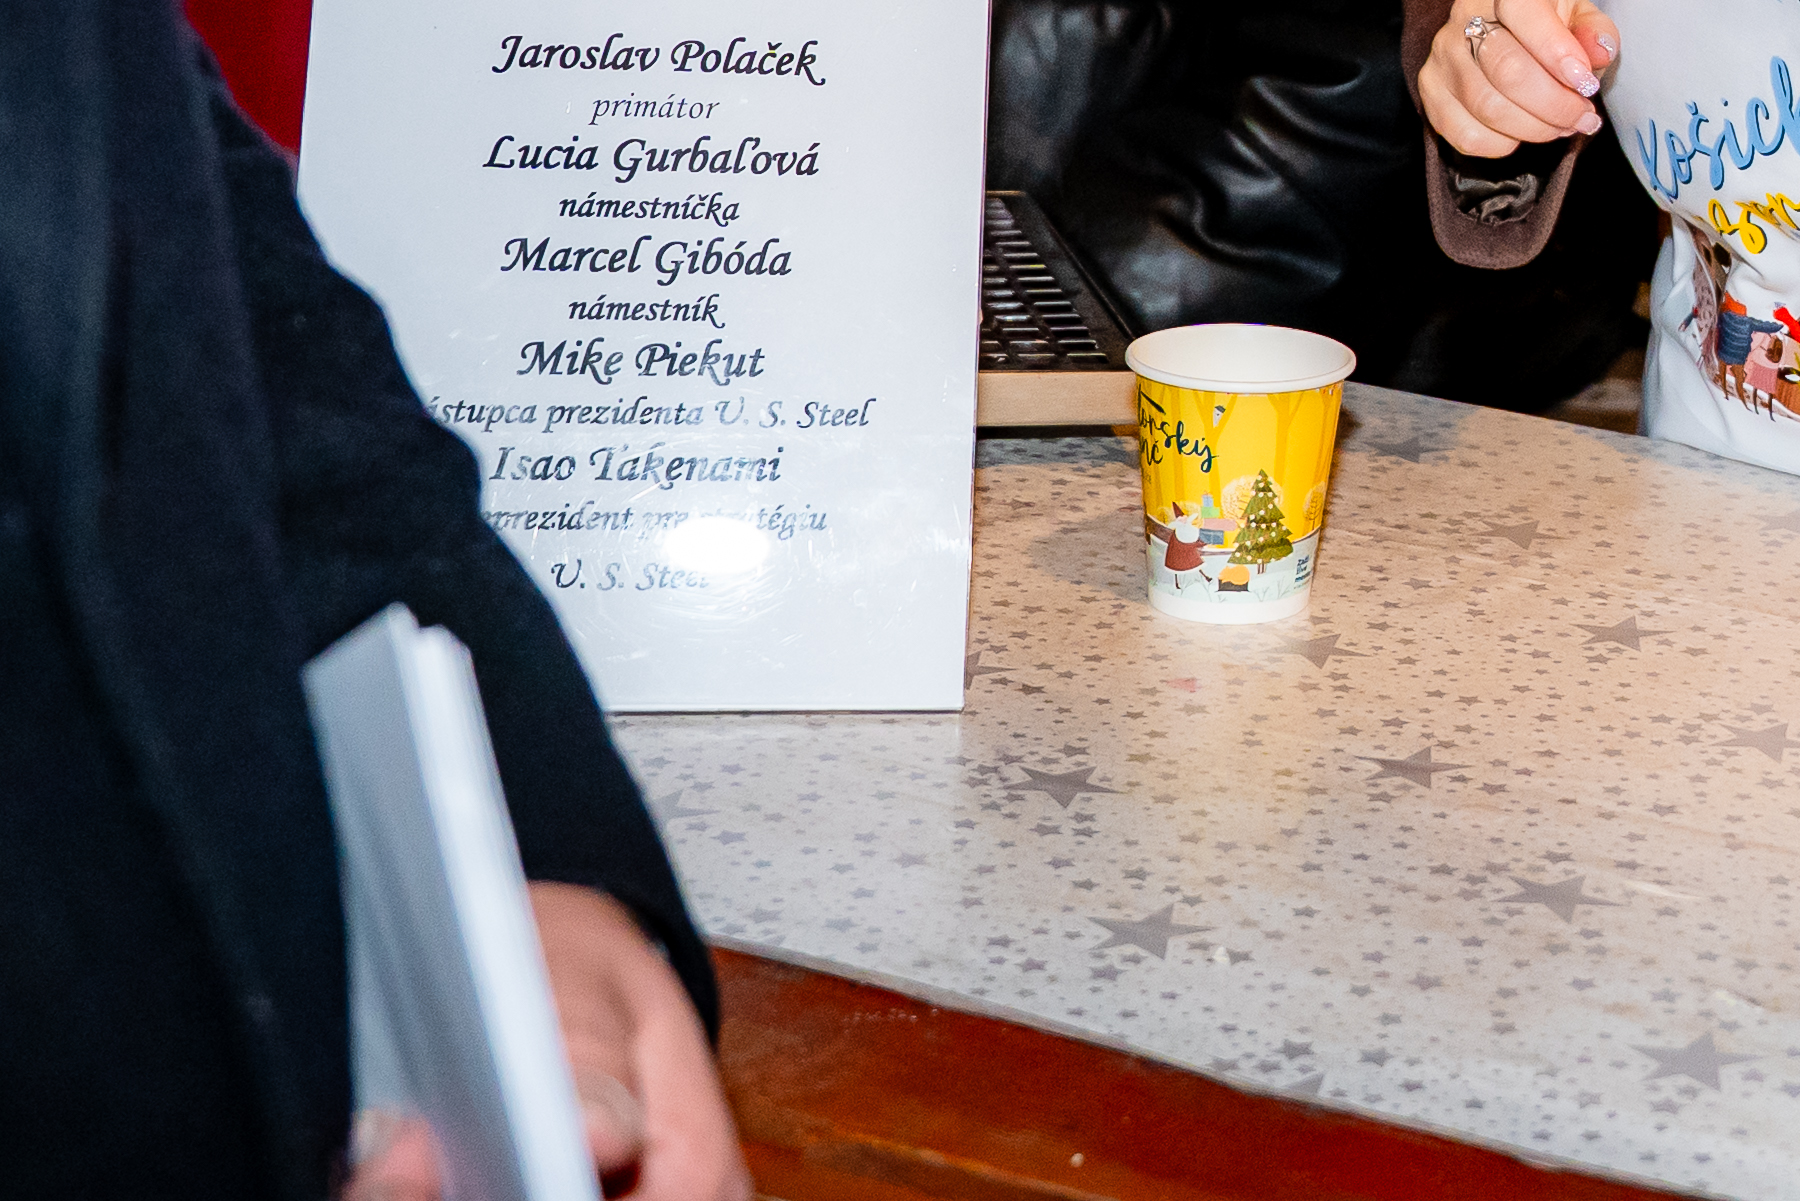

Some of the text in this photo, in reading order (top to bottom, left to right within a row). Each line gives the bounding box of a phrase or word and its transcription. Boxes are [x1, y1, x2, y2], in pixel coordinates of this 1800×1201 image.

[491, 32, 661, 75] Jaroslav
[588, 91, 720, 126] primátor
[482, 135, 820, 184] Lucia Gurbaľová
[559, 191, 740, 227] námestníčka
[500, 235, 792, 286] Marcel Gibóda
[568, 293, 726, 329] námestník
[516, 337, 766, 386] Mike Piekut
[541, 395, 703, 434] prezidenta
[715, 397, 750, 427] U.
[759, 401, 787, 428] S.
[796, 398, 876, 429] Steel
[489, 444, 785, 490] Isao Takenami
[550, 558, 586, 591] U.
[597, 562, 626, 591] S.
